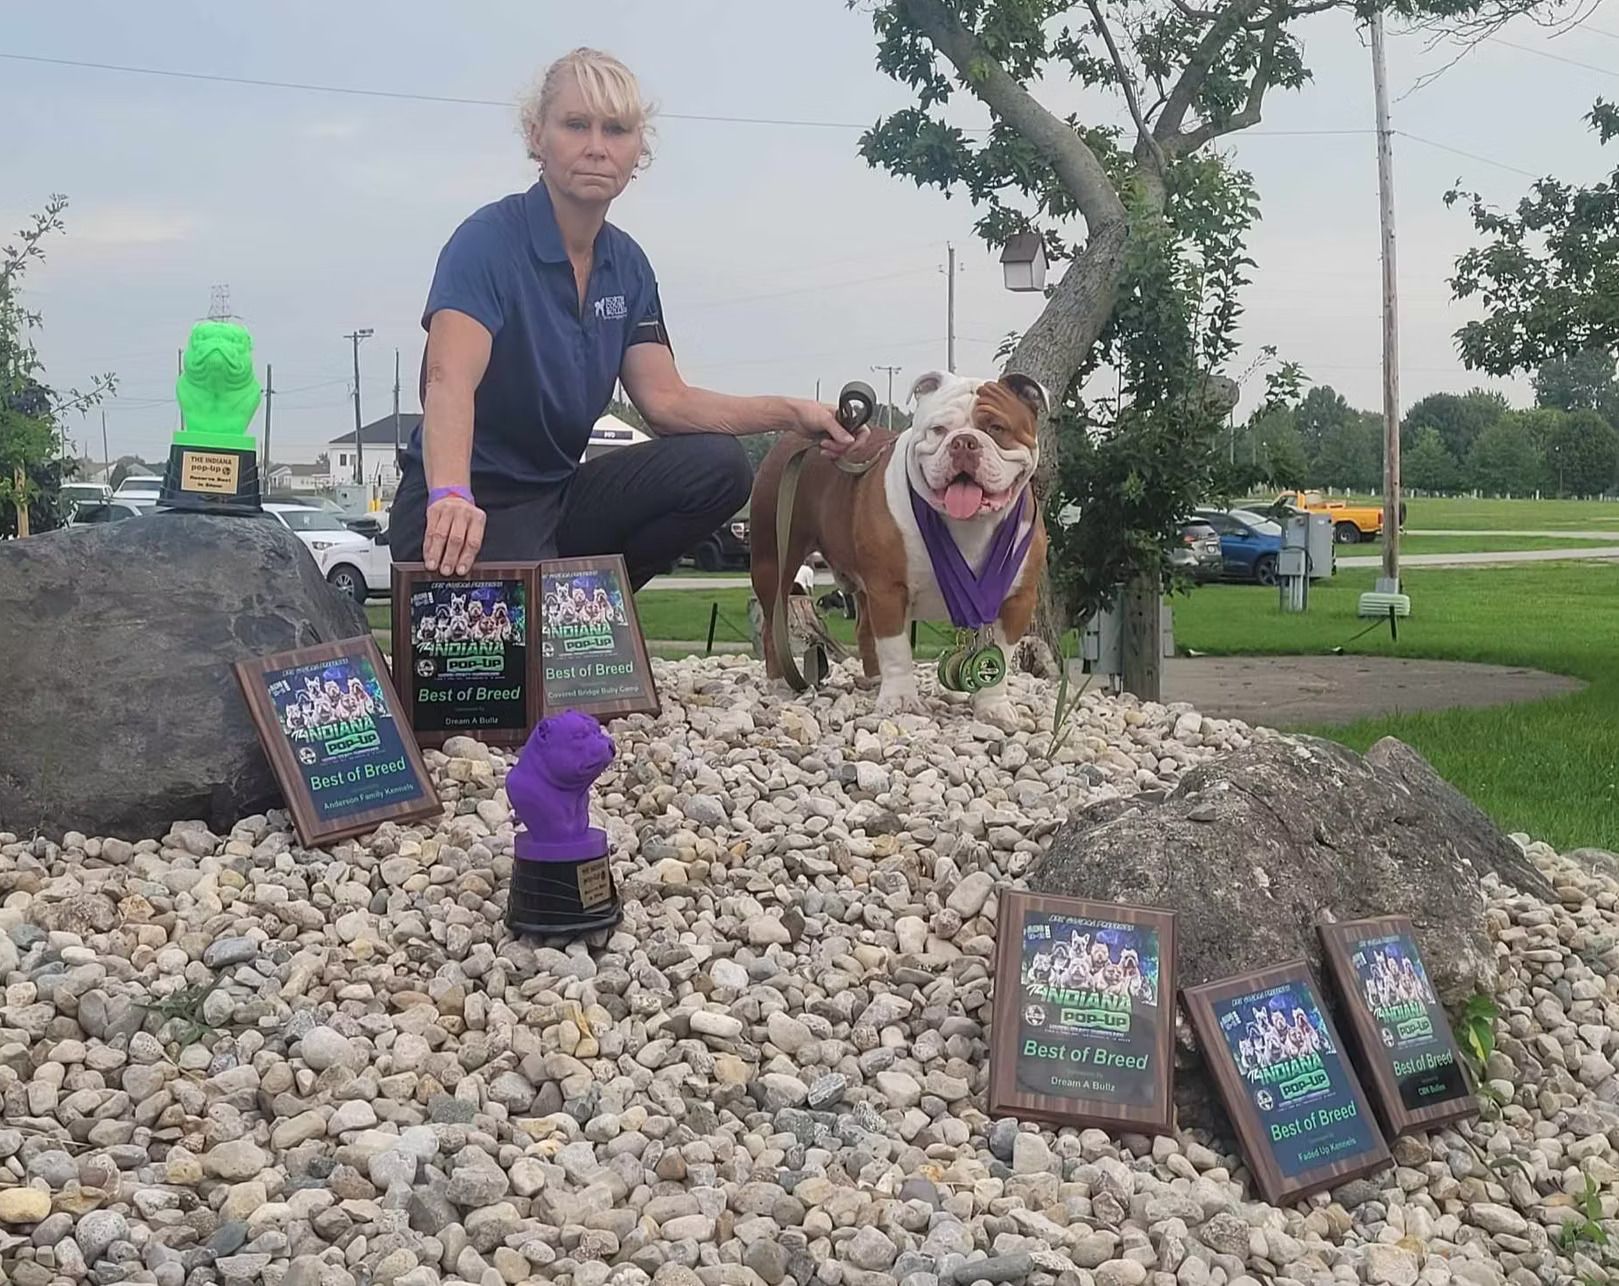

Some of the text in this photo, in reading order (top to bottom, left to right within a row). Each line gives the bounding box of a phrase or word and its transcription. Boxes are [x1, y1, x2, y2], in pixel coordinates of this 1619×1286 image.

[191, 464, 221, 473] pop-up
[205, 457, 232, 465] INDIANA
[548, 624, 612, 639] INDIANA
[430, 640, 505, 656] INDIANA
[567, 639, 612, 649] POP-UP
[449, 658, 501, 670] POP-UP
[546, 661, 634, 680] Best of Breed
[418, 686, 521, 702] Best of Breed
[578, 688, 600, 697] Bridge
[305, 717, 377, 743] INDIANA
[445, 717, 470, 725] Dream
[471, 717, 478, 725] A
[328, 733, 377, 752] POP-UP
[310, 773, 344, 790] Best
[347, 767, 362, 782] of
[365, 757, 406, 778] Breed
[324, 796, 359, 810] Anderson
[360, 791, 384, 802] Family
[385, 783, 414, 796] Kennels
[1041, 986, 1132, 1012] INDIANA
[1064, 1011, 1127, 1027] POP-UP
[1381, 1001, 1427, 1024] INDIANA
[1400, 1020, 1430, 1036] POP-UP
[1023, 1040, 1148, 1069] Best of Breed
[1393, 1048, 1453, 1077] Best of Breed
[1259, 1052, 1322, 1084] INDIANA
[1051, 1076, 1081, 1088] Dream
[1083, 1080, 1090, 1089] A
[1282, 1074, 1327, 1097] POP-UP
[1271, 1118, 1302, 1141] Best
[1305, 1112, 1316, 1130] of
[1319, 1102, 1357, 1125] Breed
[1298, 1148, 1319, 1161] Faded
[1320, 1144, 1329, 1156] Up
[1330, 1138, 1357, 1152] Kennels
